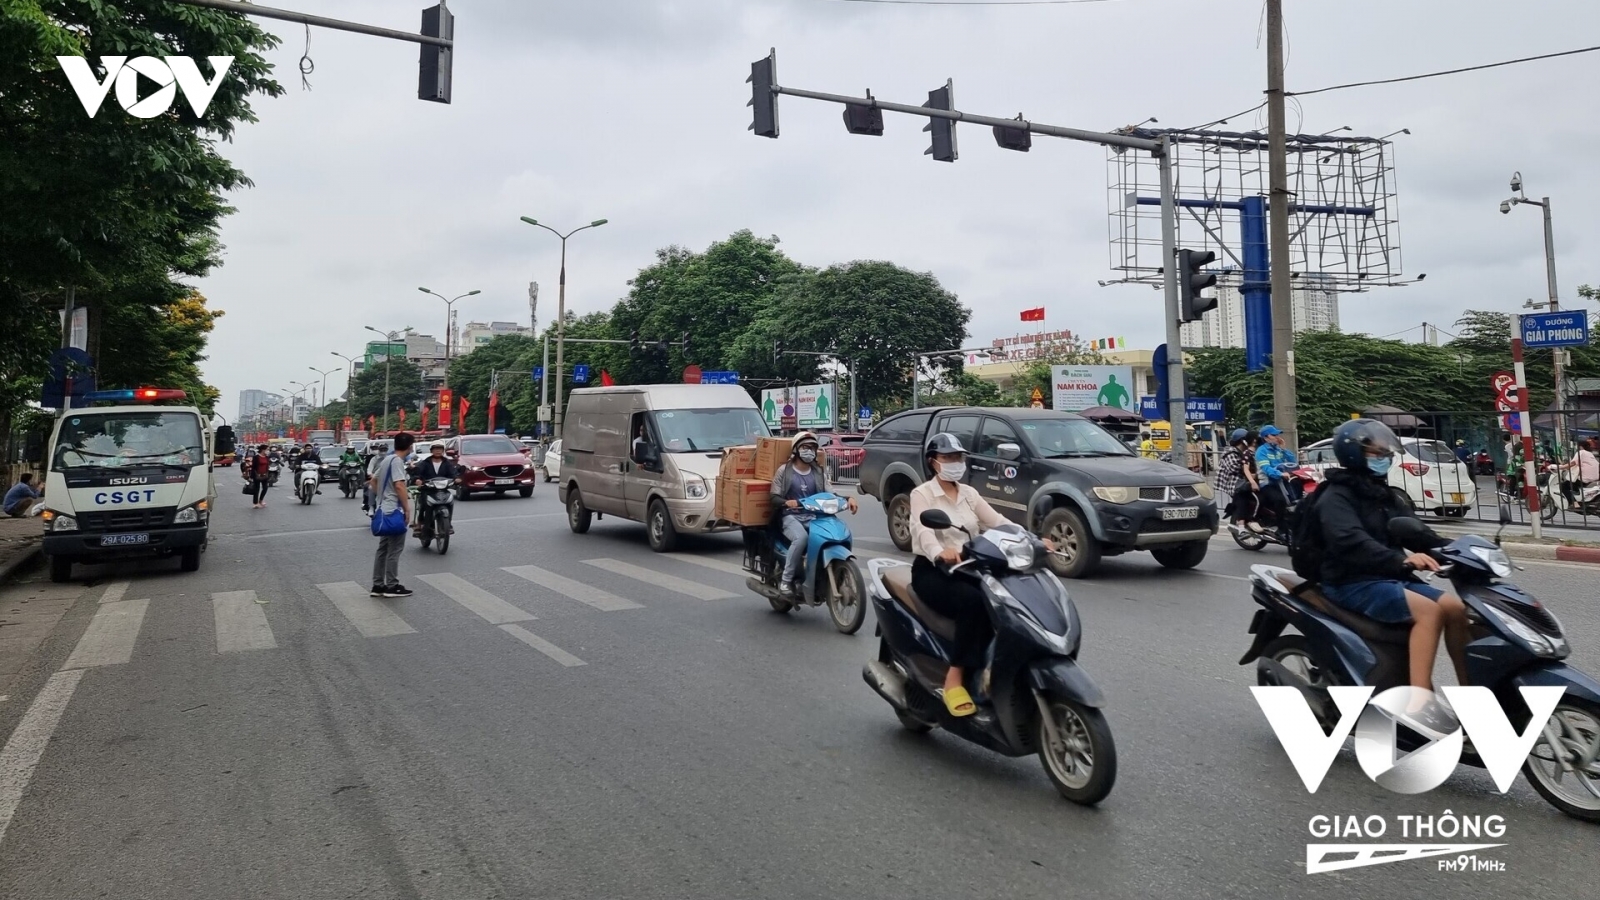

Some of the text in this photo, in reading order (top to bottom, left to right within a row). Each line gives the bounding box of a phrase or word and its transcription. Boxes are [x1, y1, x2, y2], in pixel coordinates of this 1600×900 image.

[1545, 316, 1573, 326] ĐƯỜNG
[1526, 326, 1583, 342] GIẢI PHÓNG
[1010, 349, 1024, 361] XE
[1197, 402, 1206, 410] XE
[1207, 401, 1222, 410] MÁY
[861, 409, 870, 418] 20
[1190, 410, 1205, 420] ĐÊM
[109, 477, 148, 485] ISUZU
[95, 489, 156, 505] CSGT
